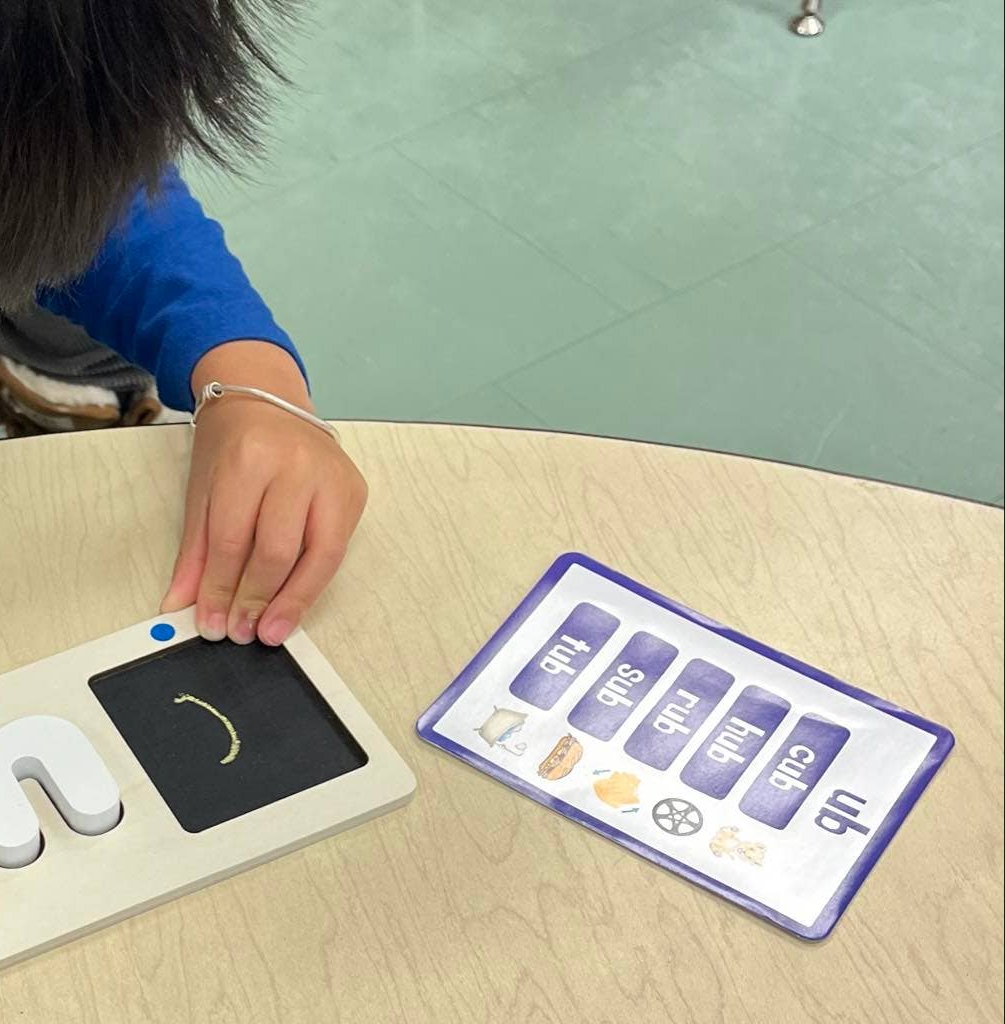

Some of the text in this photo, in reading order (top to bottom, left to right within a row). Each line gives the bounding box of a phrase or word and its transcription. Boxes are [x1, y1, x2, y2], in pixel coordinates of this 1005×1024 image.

[539, 633, 589, 675] tub
[596, 662, 645, 707] sub
[653, 687, 700, 736] rub
[706, 716, 764, 766] hub
[767, 743, 815, 793] cub
[814, 786, 870, 838] ub
